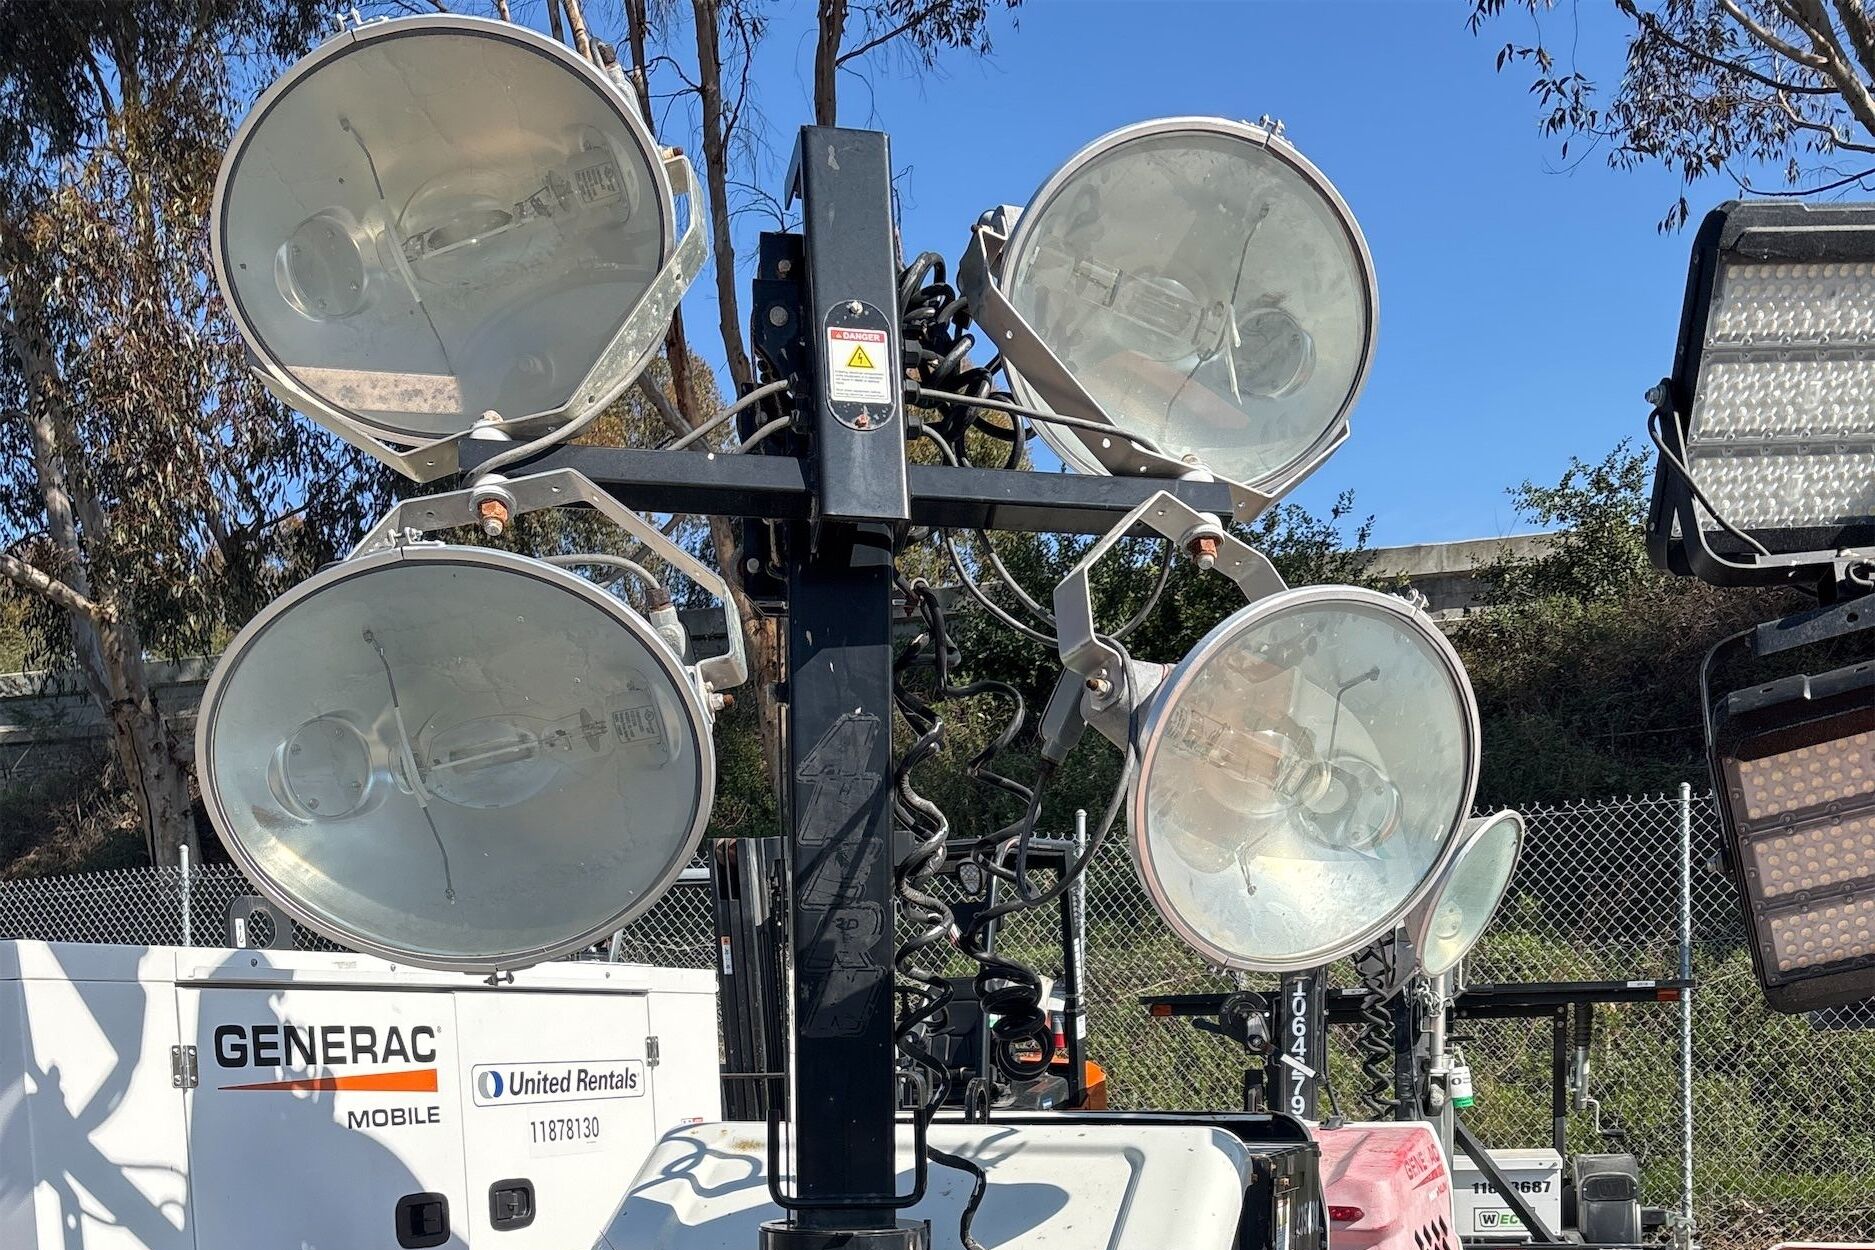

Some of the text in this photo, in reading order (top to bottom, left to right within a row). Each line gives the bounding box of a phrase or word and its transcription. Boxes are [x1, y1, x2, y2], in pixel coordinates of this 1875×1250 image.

[843, 332, 880, 341] DANGER
[214, 1025, 436, 1067] GENERAC
[1291, 981, 1307, 1122] 106479
[509, 1067, 637, 1096] United Rentals
[348, 1106, 440, 1129] MOBILE
[530, 1116, 599, 1143] 11878130
[1404, 1144, 1440, 1180] GENEAC
[1472, 1181, 1551, 1194] 1183687
